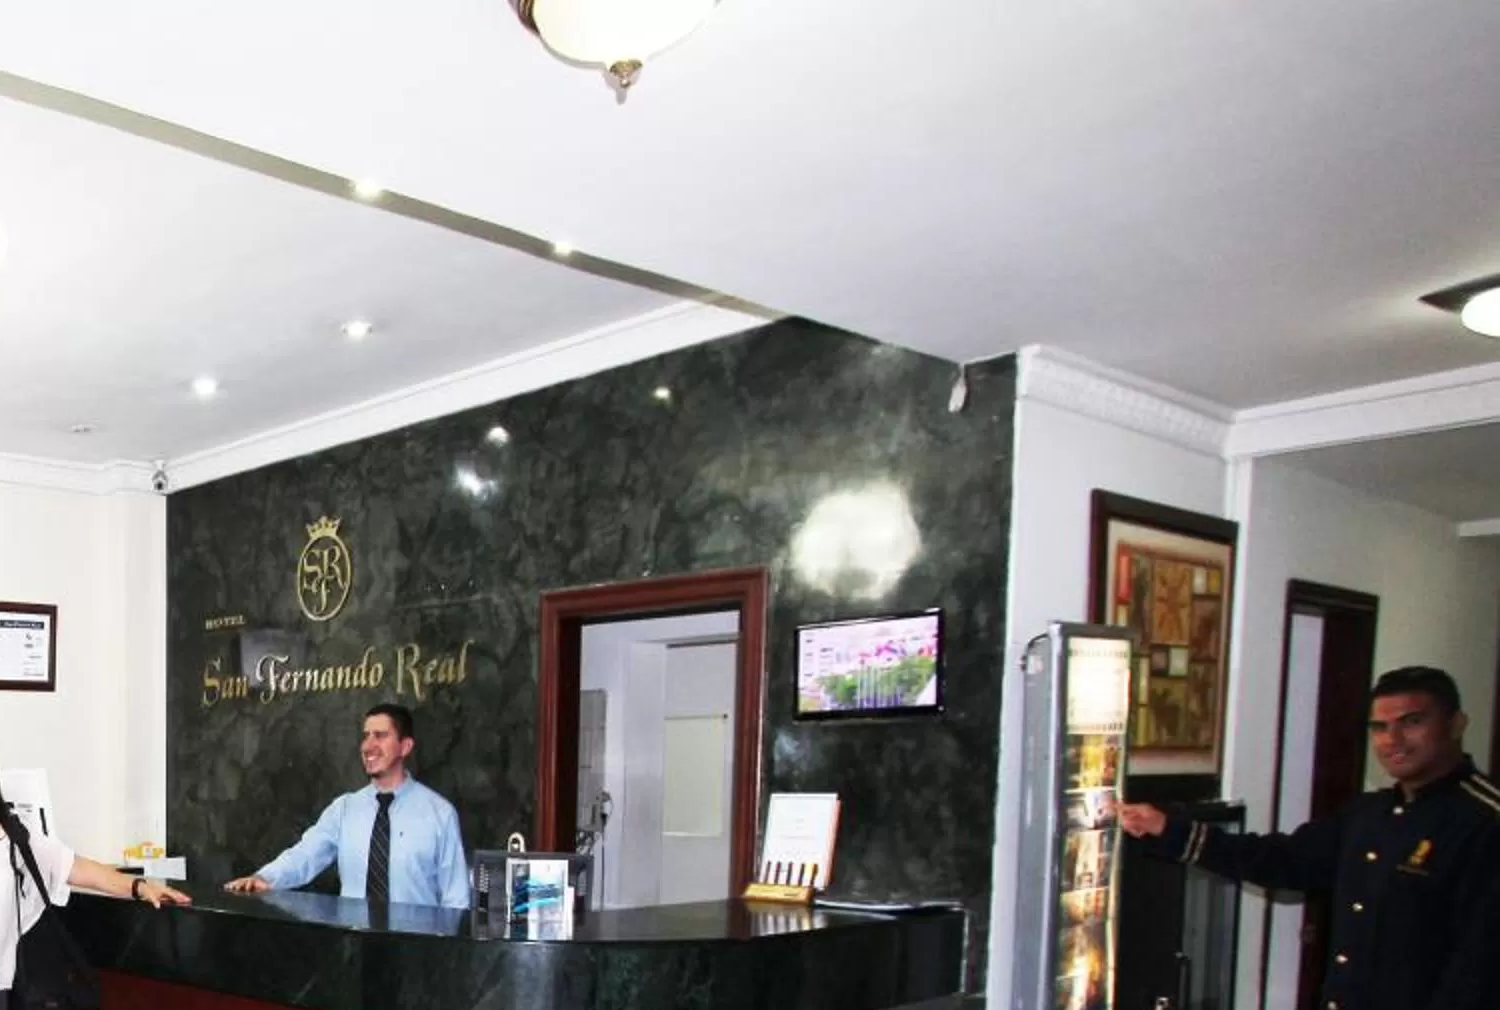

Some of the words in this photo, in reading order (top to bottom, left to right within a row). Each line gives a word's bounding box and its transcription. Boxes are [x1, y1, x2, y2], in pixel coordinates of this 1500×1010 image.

[205, 615, 245, 630] HOTEL
[202, 658, 247, 705] San
[257, 648, 383, 704] Fernando
[397, 640, 474, 701] Real
